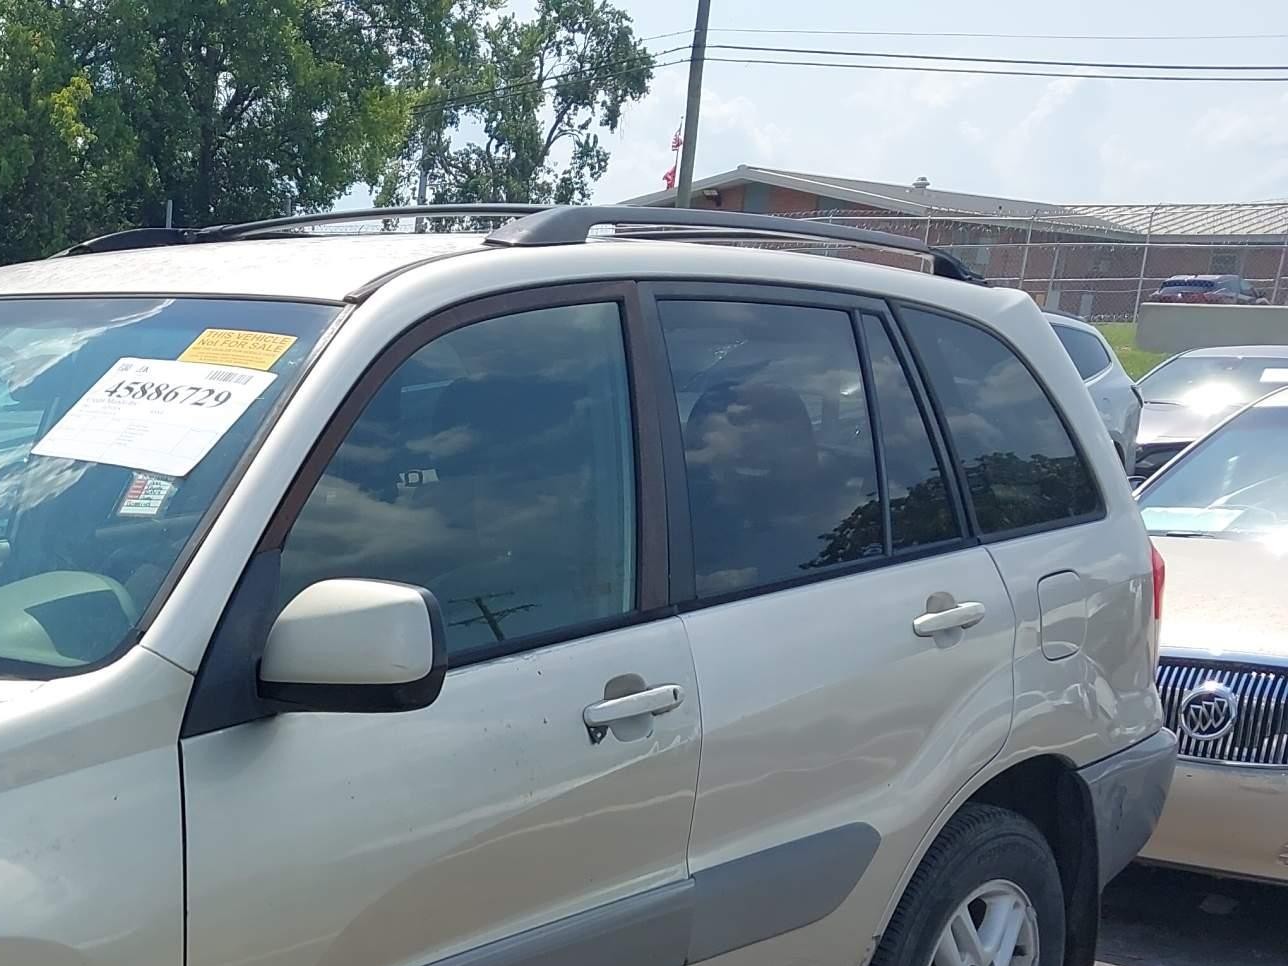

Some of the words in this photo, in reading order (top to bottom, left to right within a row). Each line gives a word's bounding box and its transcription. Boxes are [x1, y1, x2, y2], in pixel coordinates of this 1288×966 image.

[206, 330, 234, 339] THIS
[236, 332, 289, 345] VEHICLE
[222, 340, 247, 349] FOR
[248, 342, 284, 353] SALE
[104, 380, 232, 408] 45886729
